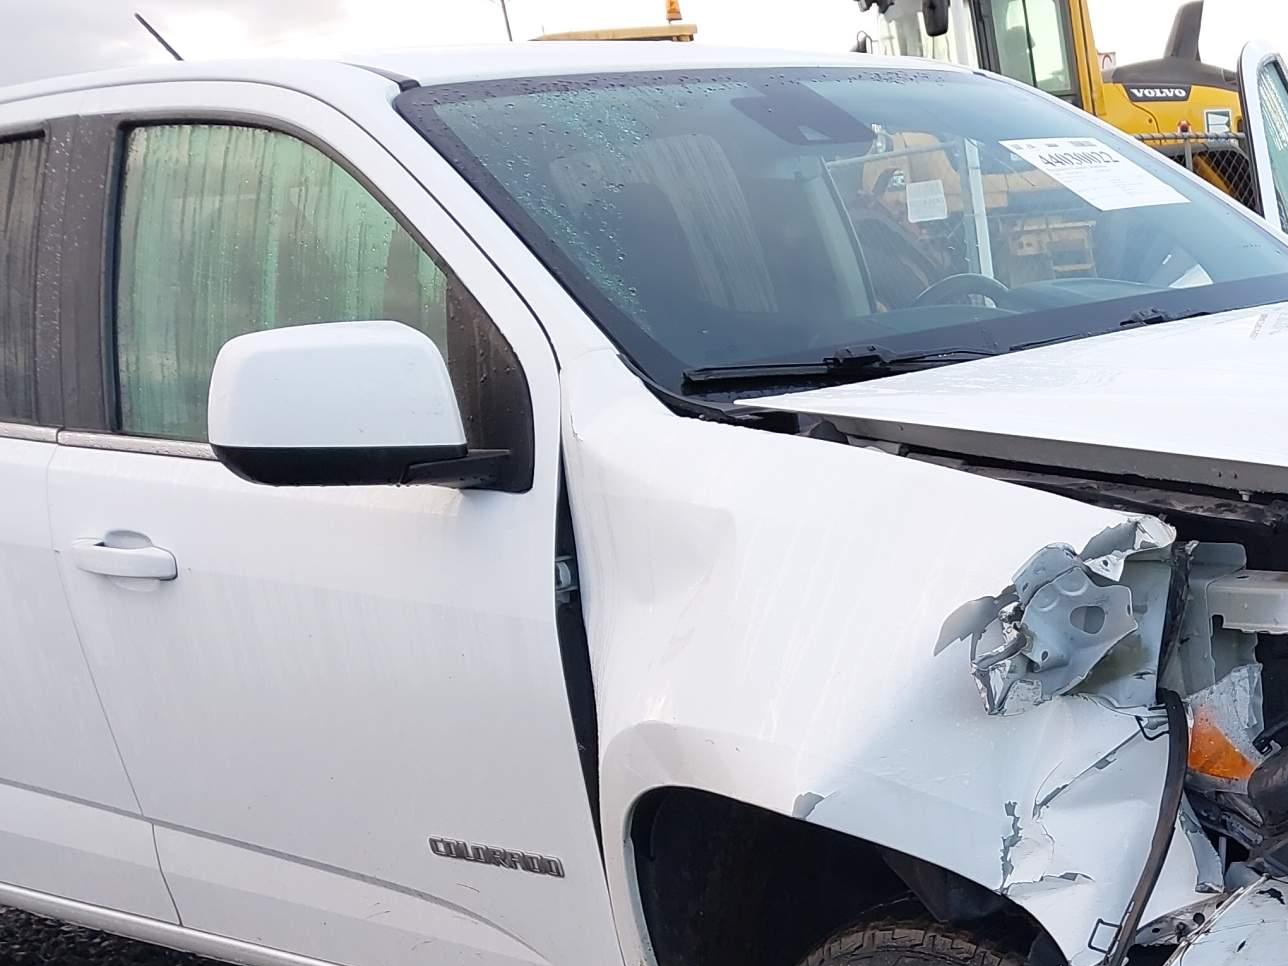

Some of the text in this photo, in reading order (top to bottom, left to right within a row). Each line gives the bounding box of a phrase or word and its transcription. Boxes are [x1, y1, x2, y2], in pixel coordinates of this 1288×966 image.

[1130, 88, 1187, 98] VOLVO
[1038, 151, 1120, 167] 44030022
[428, 837, 565, 878] COLORADO
